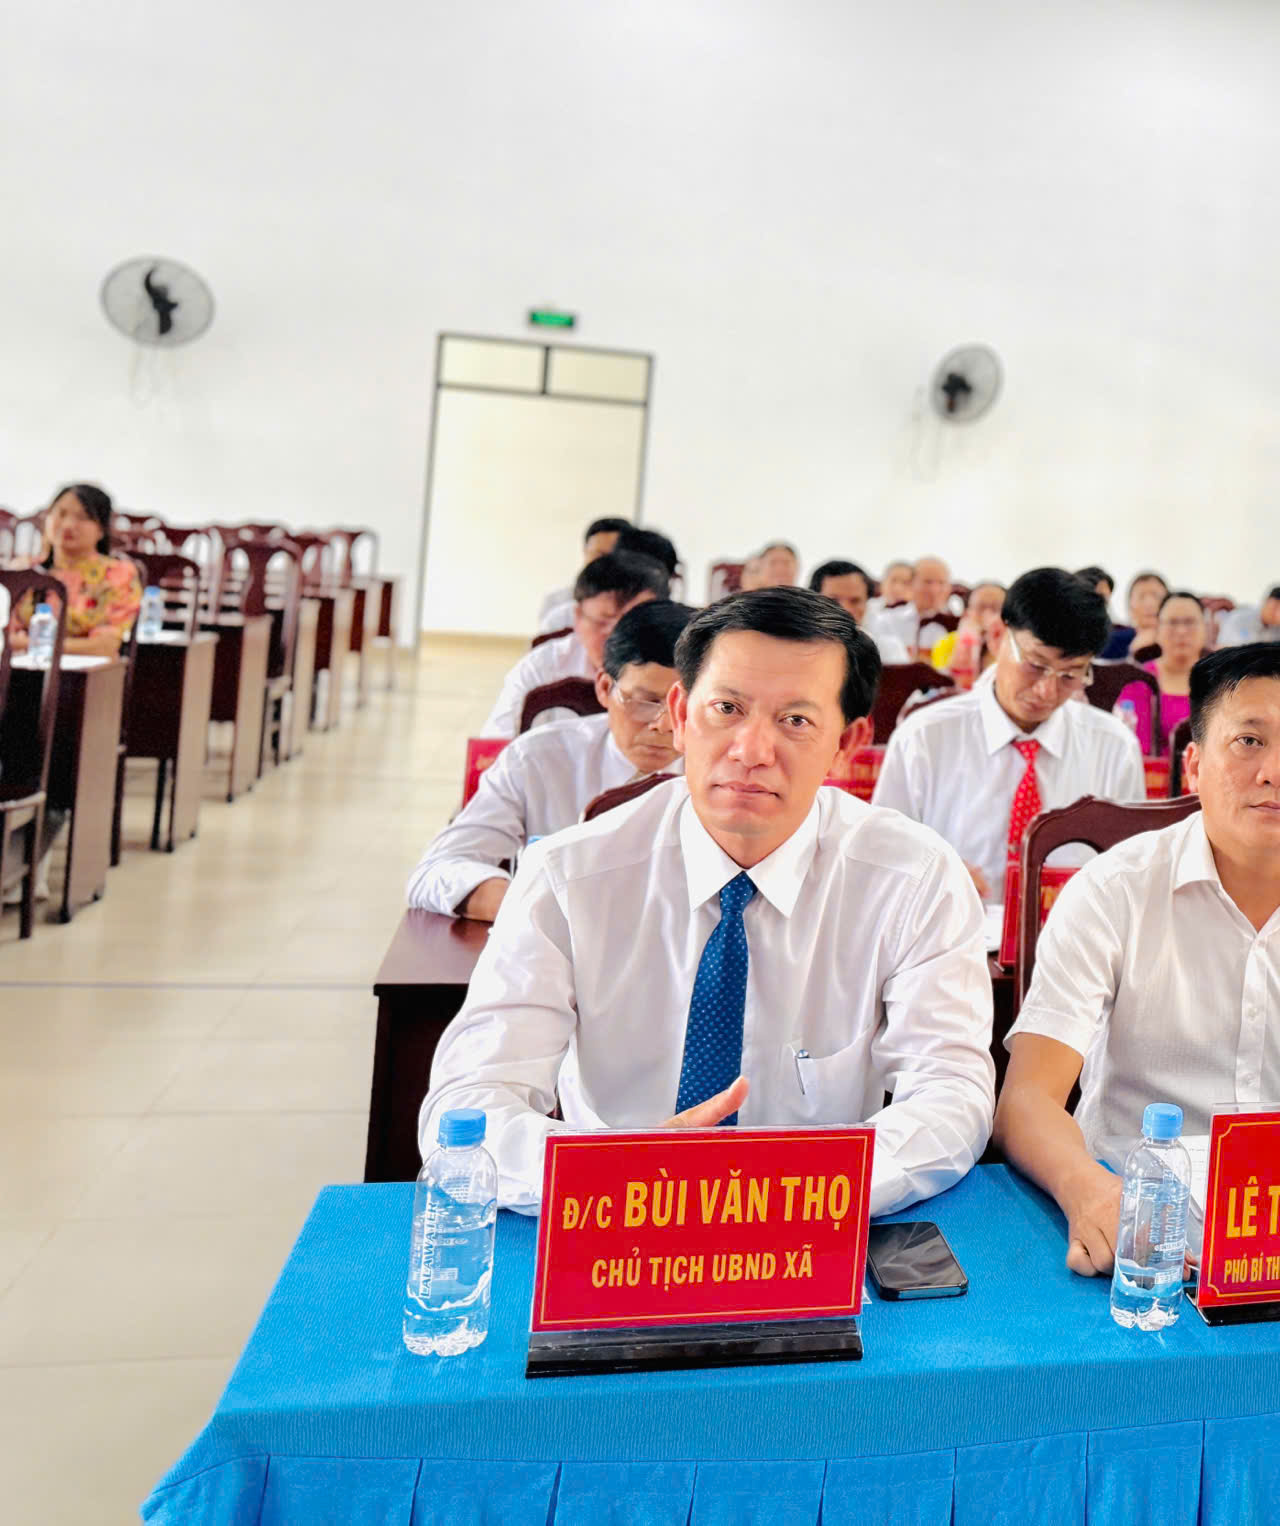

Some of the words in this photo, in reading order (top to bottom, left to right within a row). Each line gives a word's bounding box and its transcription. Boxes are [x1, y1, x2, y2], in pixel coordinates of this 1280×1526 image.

[562, 1195, 613, 1230] Đ/C
[623, 1167, 688, 1228] BÙI
[699, 1168, 770, 1224] VĂN
[780, 1174, 851, 1233] THỌ
[1226, 1175, 1260, 1238] LÊ
[420, 1199, 439, 1298] LALAWATER
[591, 1246, 642, 1289] CHỦ
[648, 1254, 705, 1292] TỊCH
[712, 1252, 777, 1282] UBND
[783, 1244, 813, 1280] XÃ
[1223, 1253, 1248, 1284] PHÓ
[1250, 1252, 1264, 1282] BÍ
